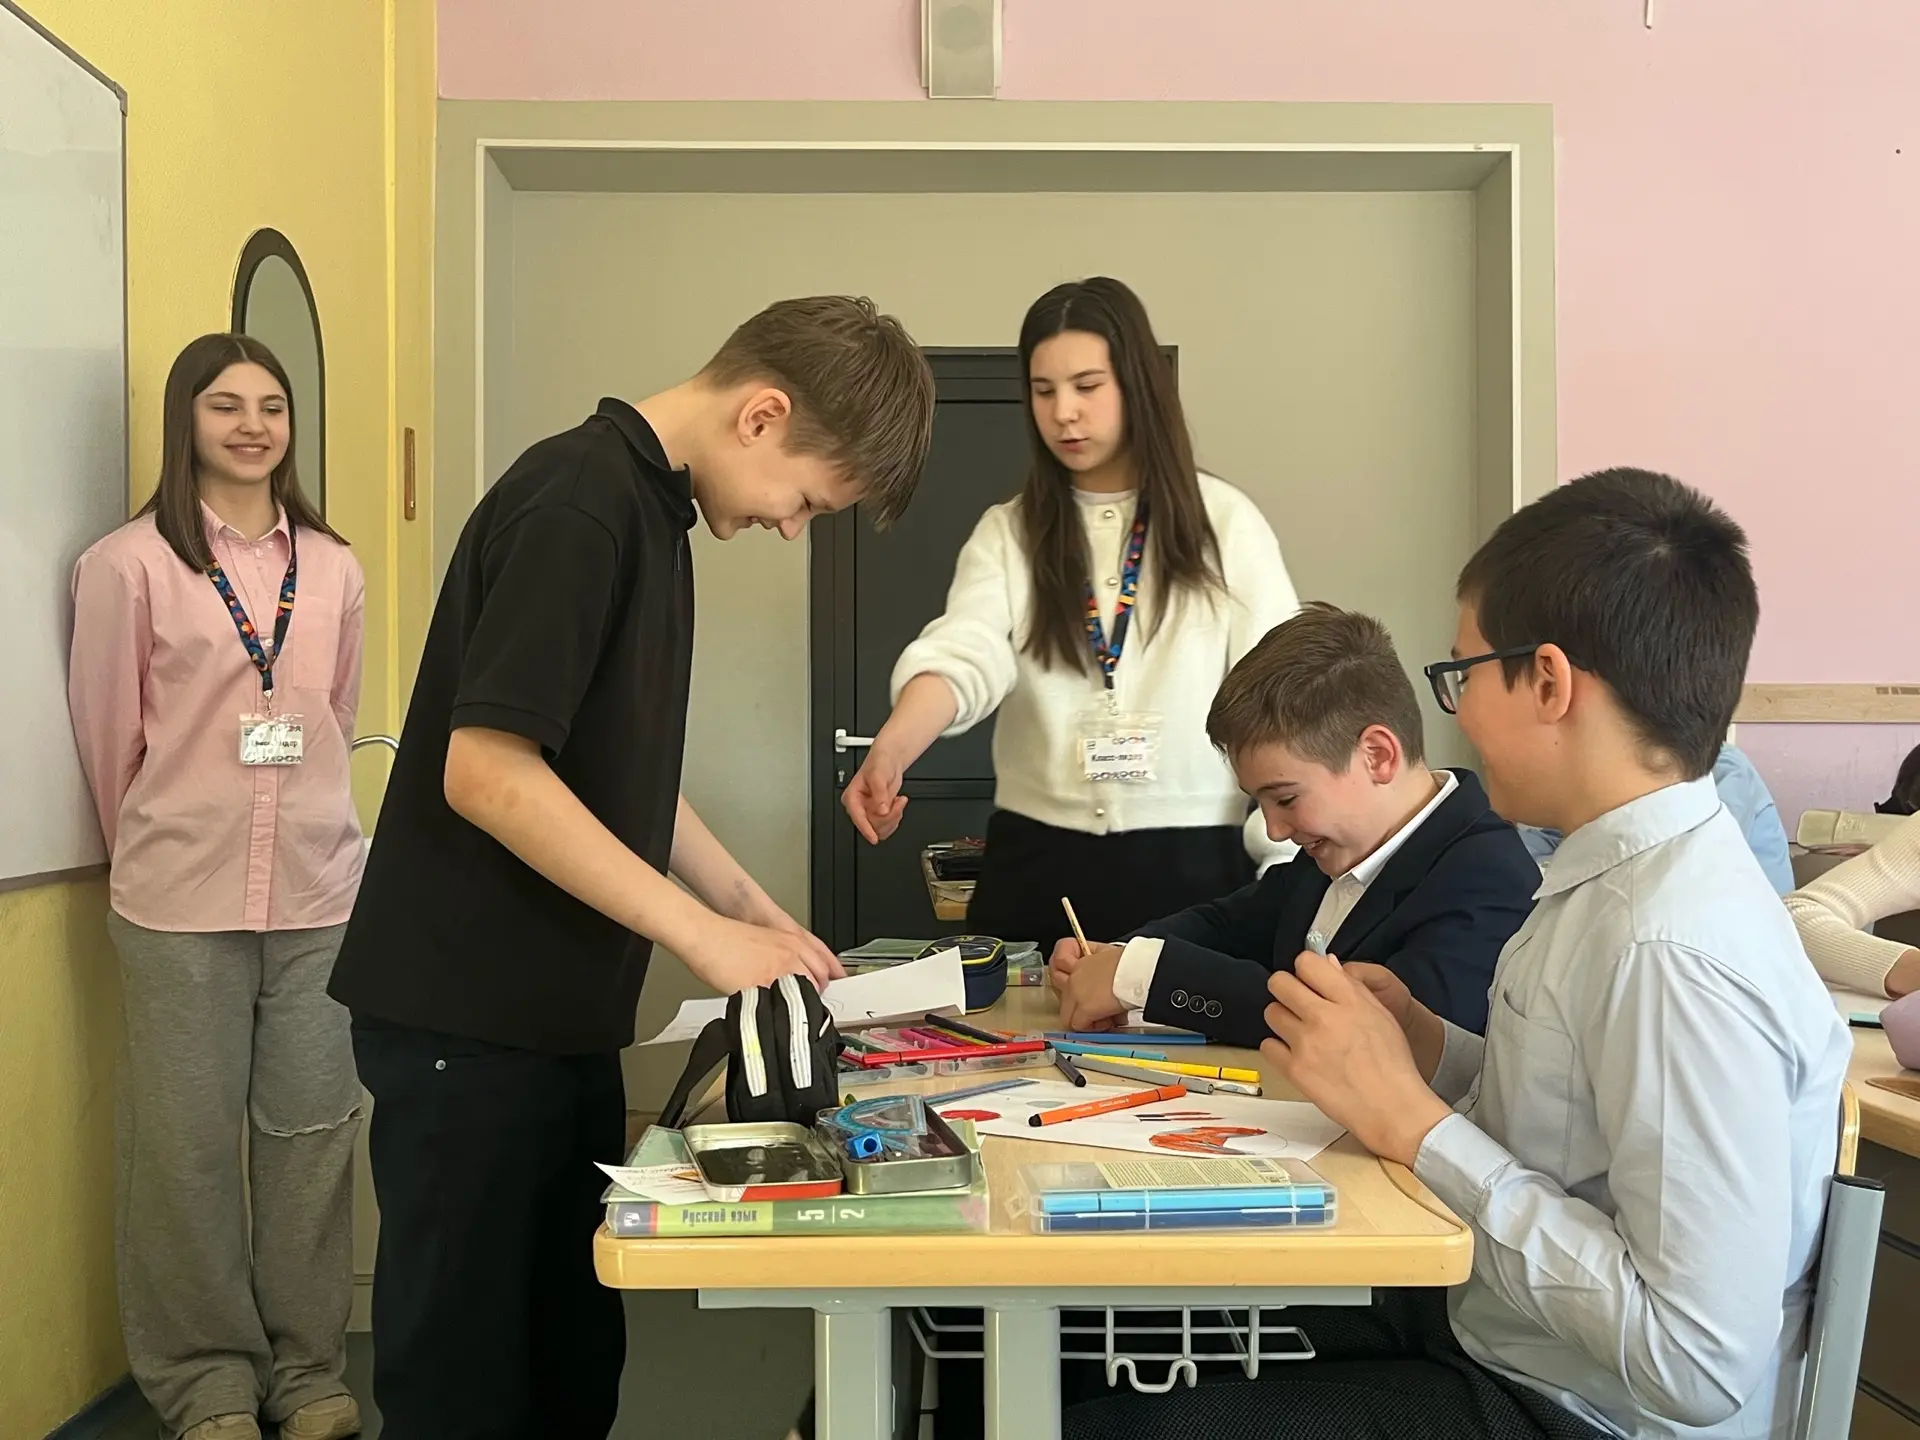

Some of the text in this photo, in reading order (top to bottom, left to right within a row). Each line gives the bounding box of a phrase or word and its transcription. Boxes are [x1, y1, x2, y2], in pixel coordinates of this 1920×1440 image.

[682, 1208, 757, 1227] Русский язык
[797, 1208, 825, 1221] 5
[839, 1208, 865, 1219] 2
